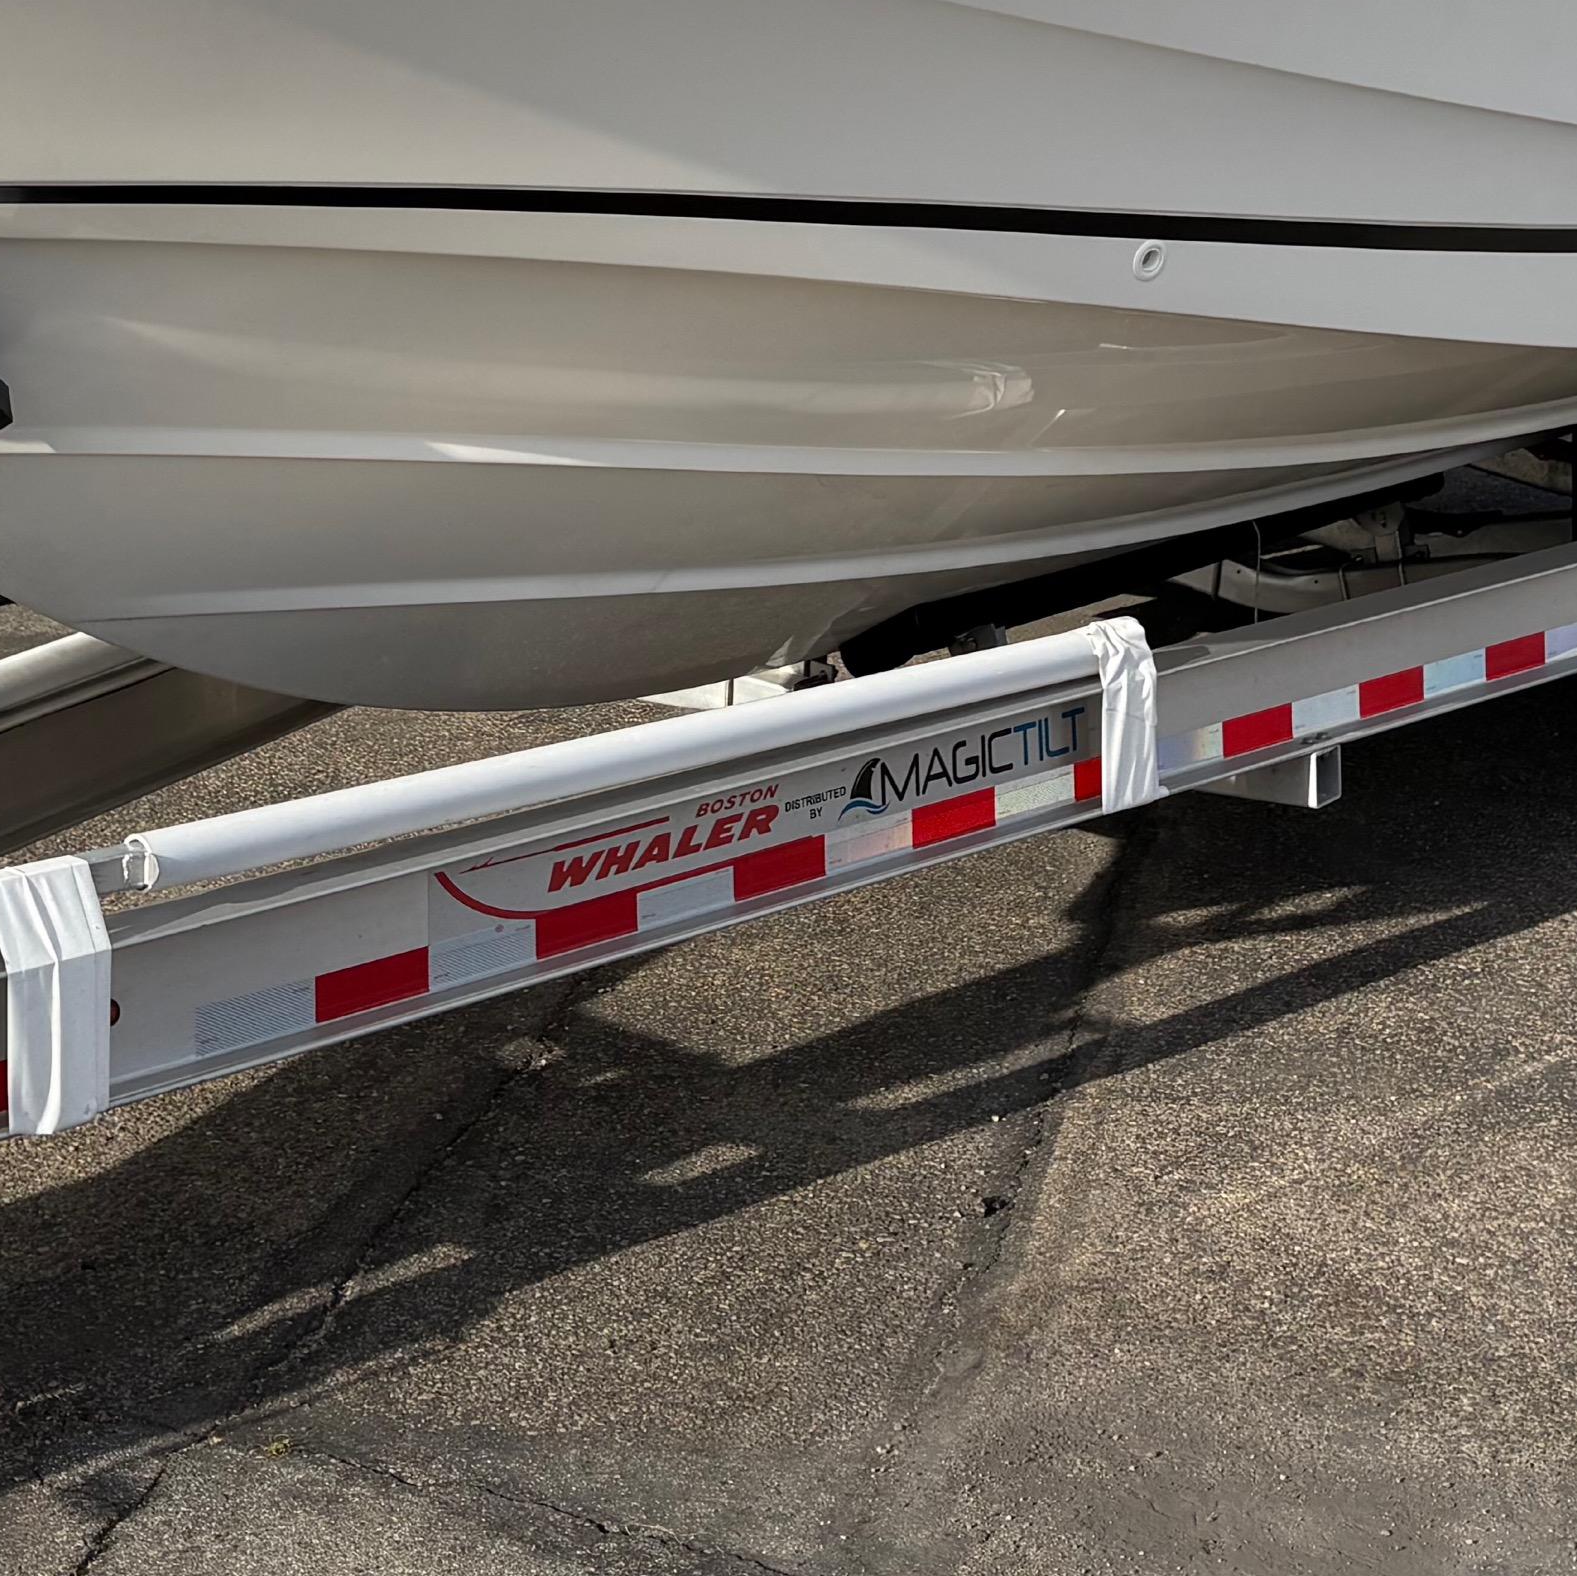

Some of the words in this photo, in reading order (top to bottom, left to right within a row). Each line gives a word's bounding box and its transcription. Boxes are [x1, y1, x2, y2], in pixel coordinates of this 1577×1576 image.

[694, 783, 780, 819] BOSTON
[784, 785, 847, 813] DISTRIBUTED
[808, 806, 823, 820] BY
[546, 803, 781, 894] WHALER
